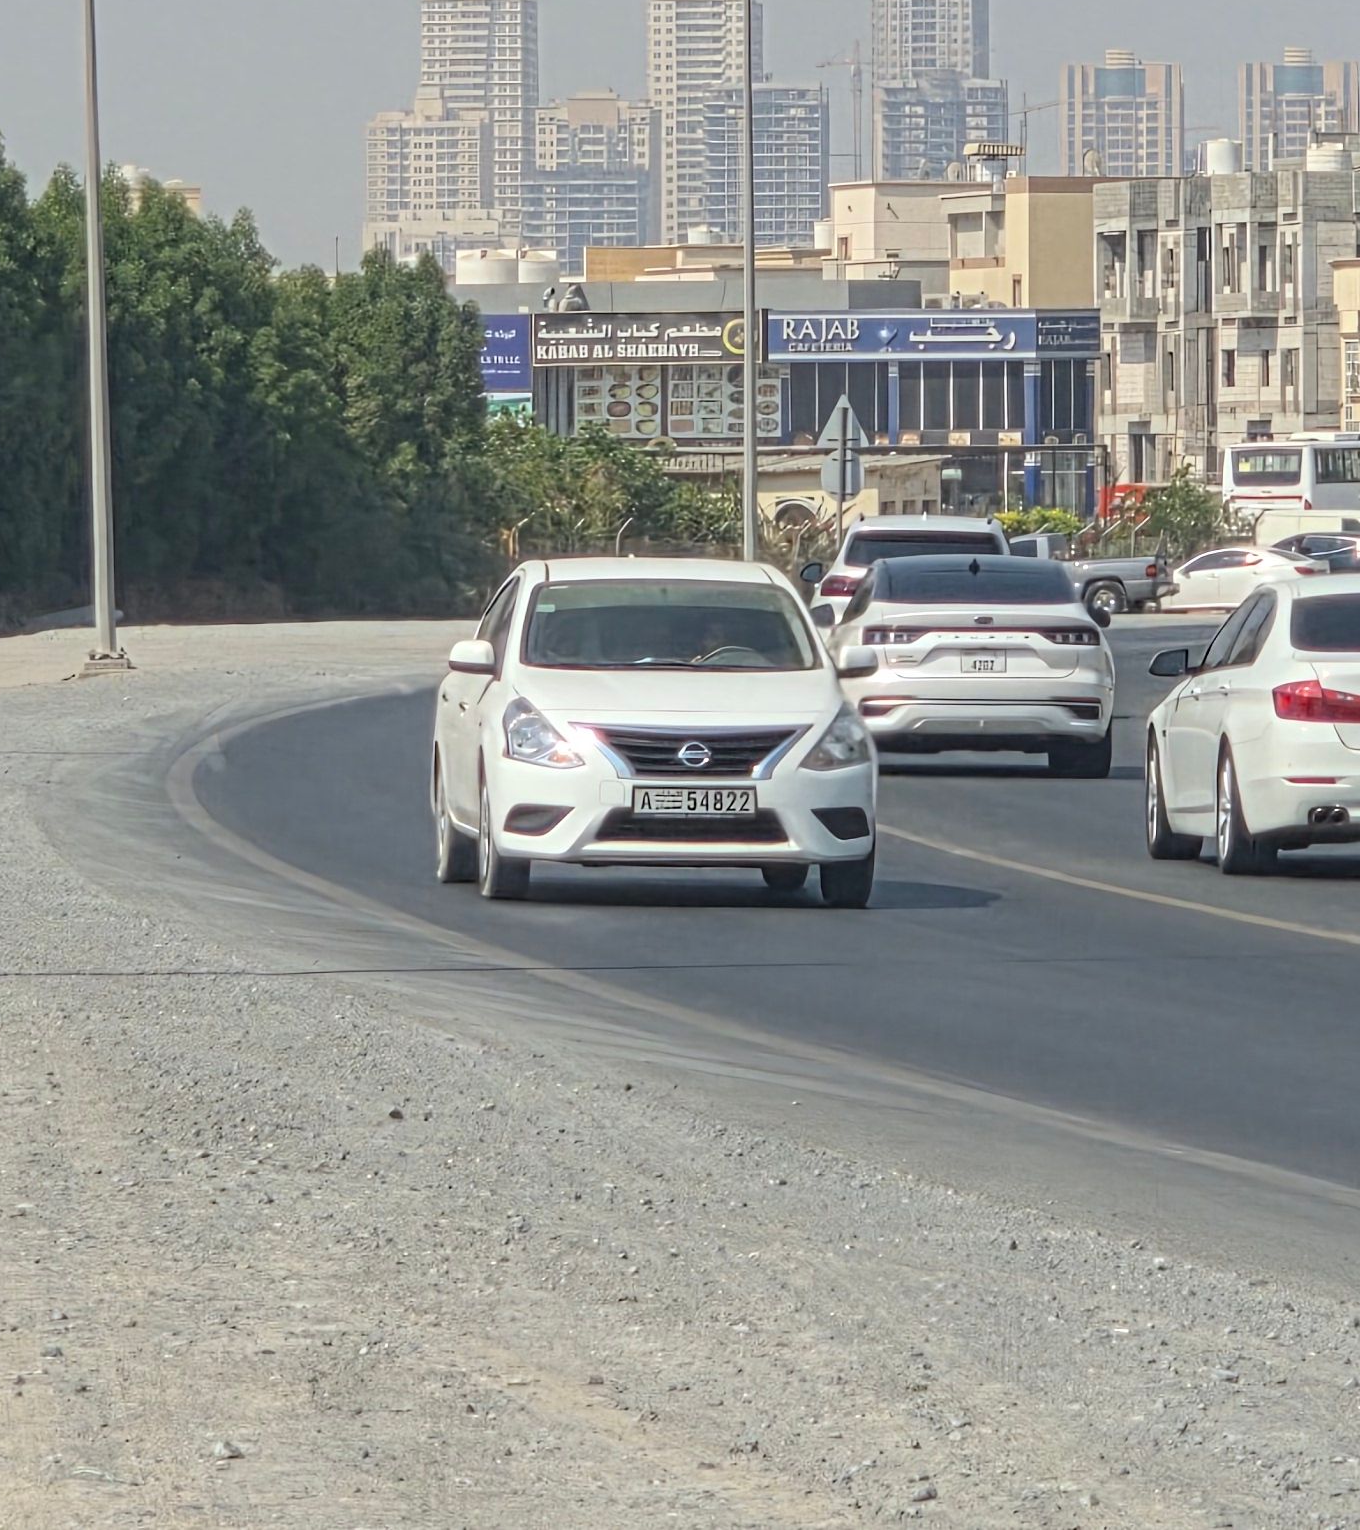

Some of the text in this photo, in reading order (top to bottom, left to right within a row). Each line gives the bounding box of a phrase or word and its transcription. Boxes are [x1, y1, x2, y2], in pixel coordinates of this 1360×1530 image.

[782, 319, 860, 343] RAJAB
[537, 345, 589, 359] KABAB
[593, 345, 613, 359] AL
[640, 791, 652, 810] A
[687, 791, 750, 811] 54822
